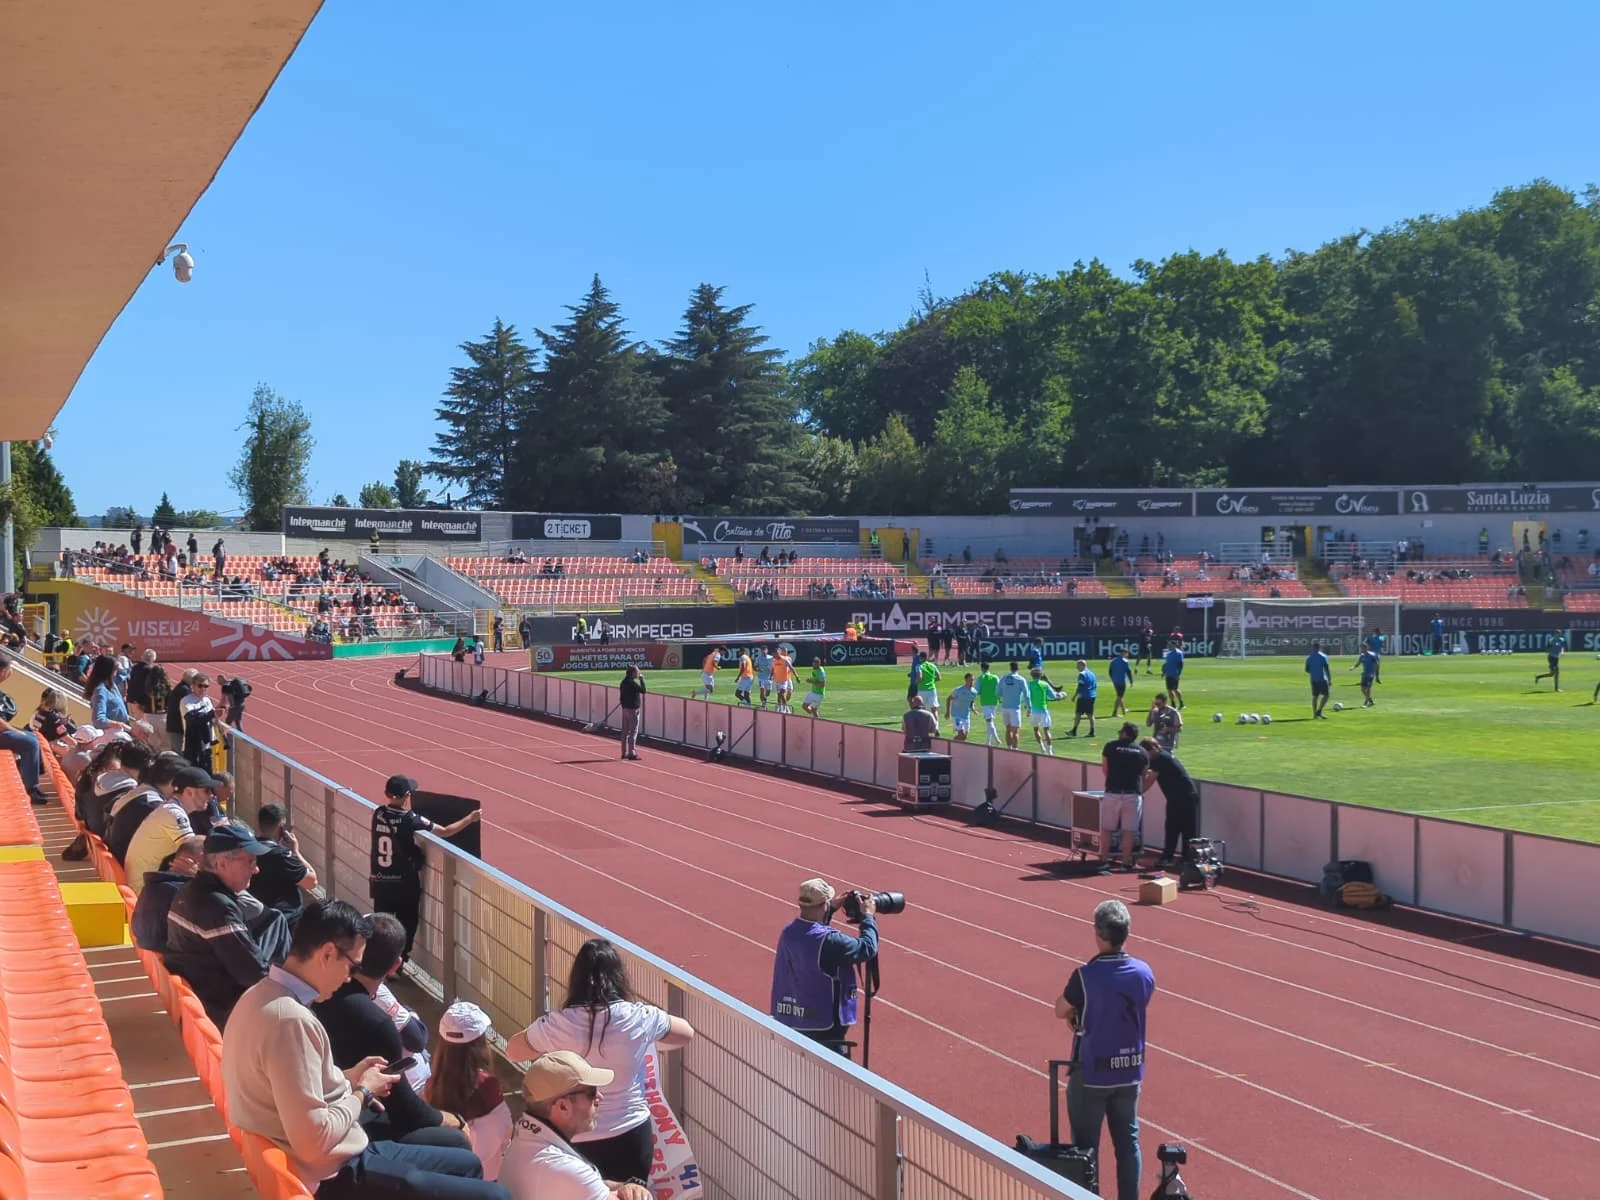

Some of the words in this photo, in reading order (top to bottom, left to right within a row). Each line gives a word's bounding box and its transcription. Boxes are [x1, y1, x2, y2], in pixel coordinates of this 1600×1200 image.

[1466, 490, 1508, 505] Santa
[1510, 489, 1550, 505] Luzia
[290, 515, 347, 527] Intermarché
[355, 517, 413, 529] Intermarché
[421, 519, 477, 530] Intermarché
[763, 620, 795, 632] SINCE
[800, 618, 826, 631] 1996
[1080, 616, 1116, 627] SINCE
[1123, 616, 1150, 627] 1996
[1446, 616, 1473, 627] INCE
[849, 646, 888, 657] LEGADO
[1005, 641, 1086, 656] HYNDAI
[570, 654, 608, 662] BILHETES
[633, 653, 645, 661] OS
[562, 662, 589, 670] JOGOS
[590, 662, 609, 670] LIGA
[378, 835, 393, 868] 9
[1110, 1056, 1130, 1069] FOTO
[678, 1163, 700, 1191] 41
